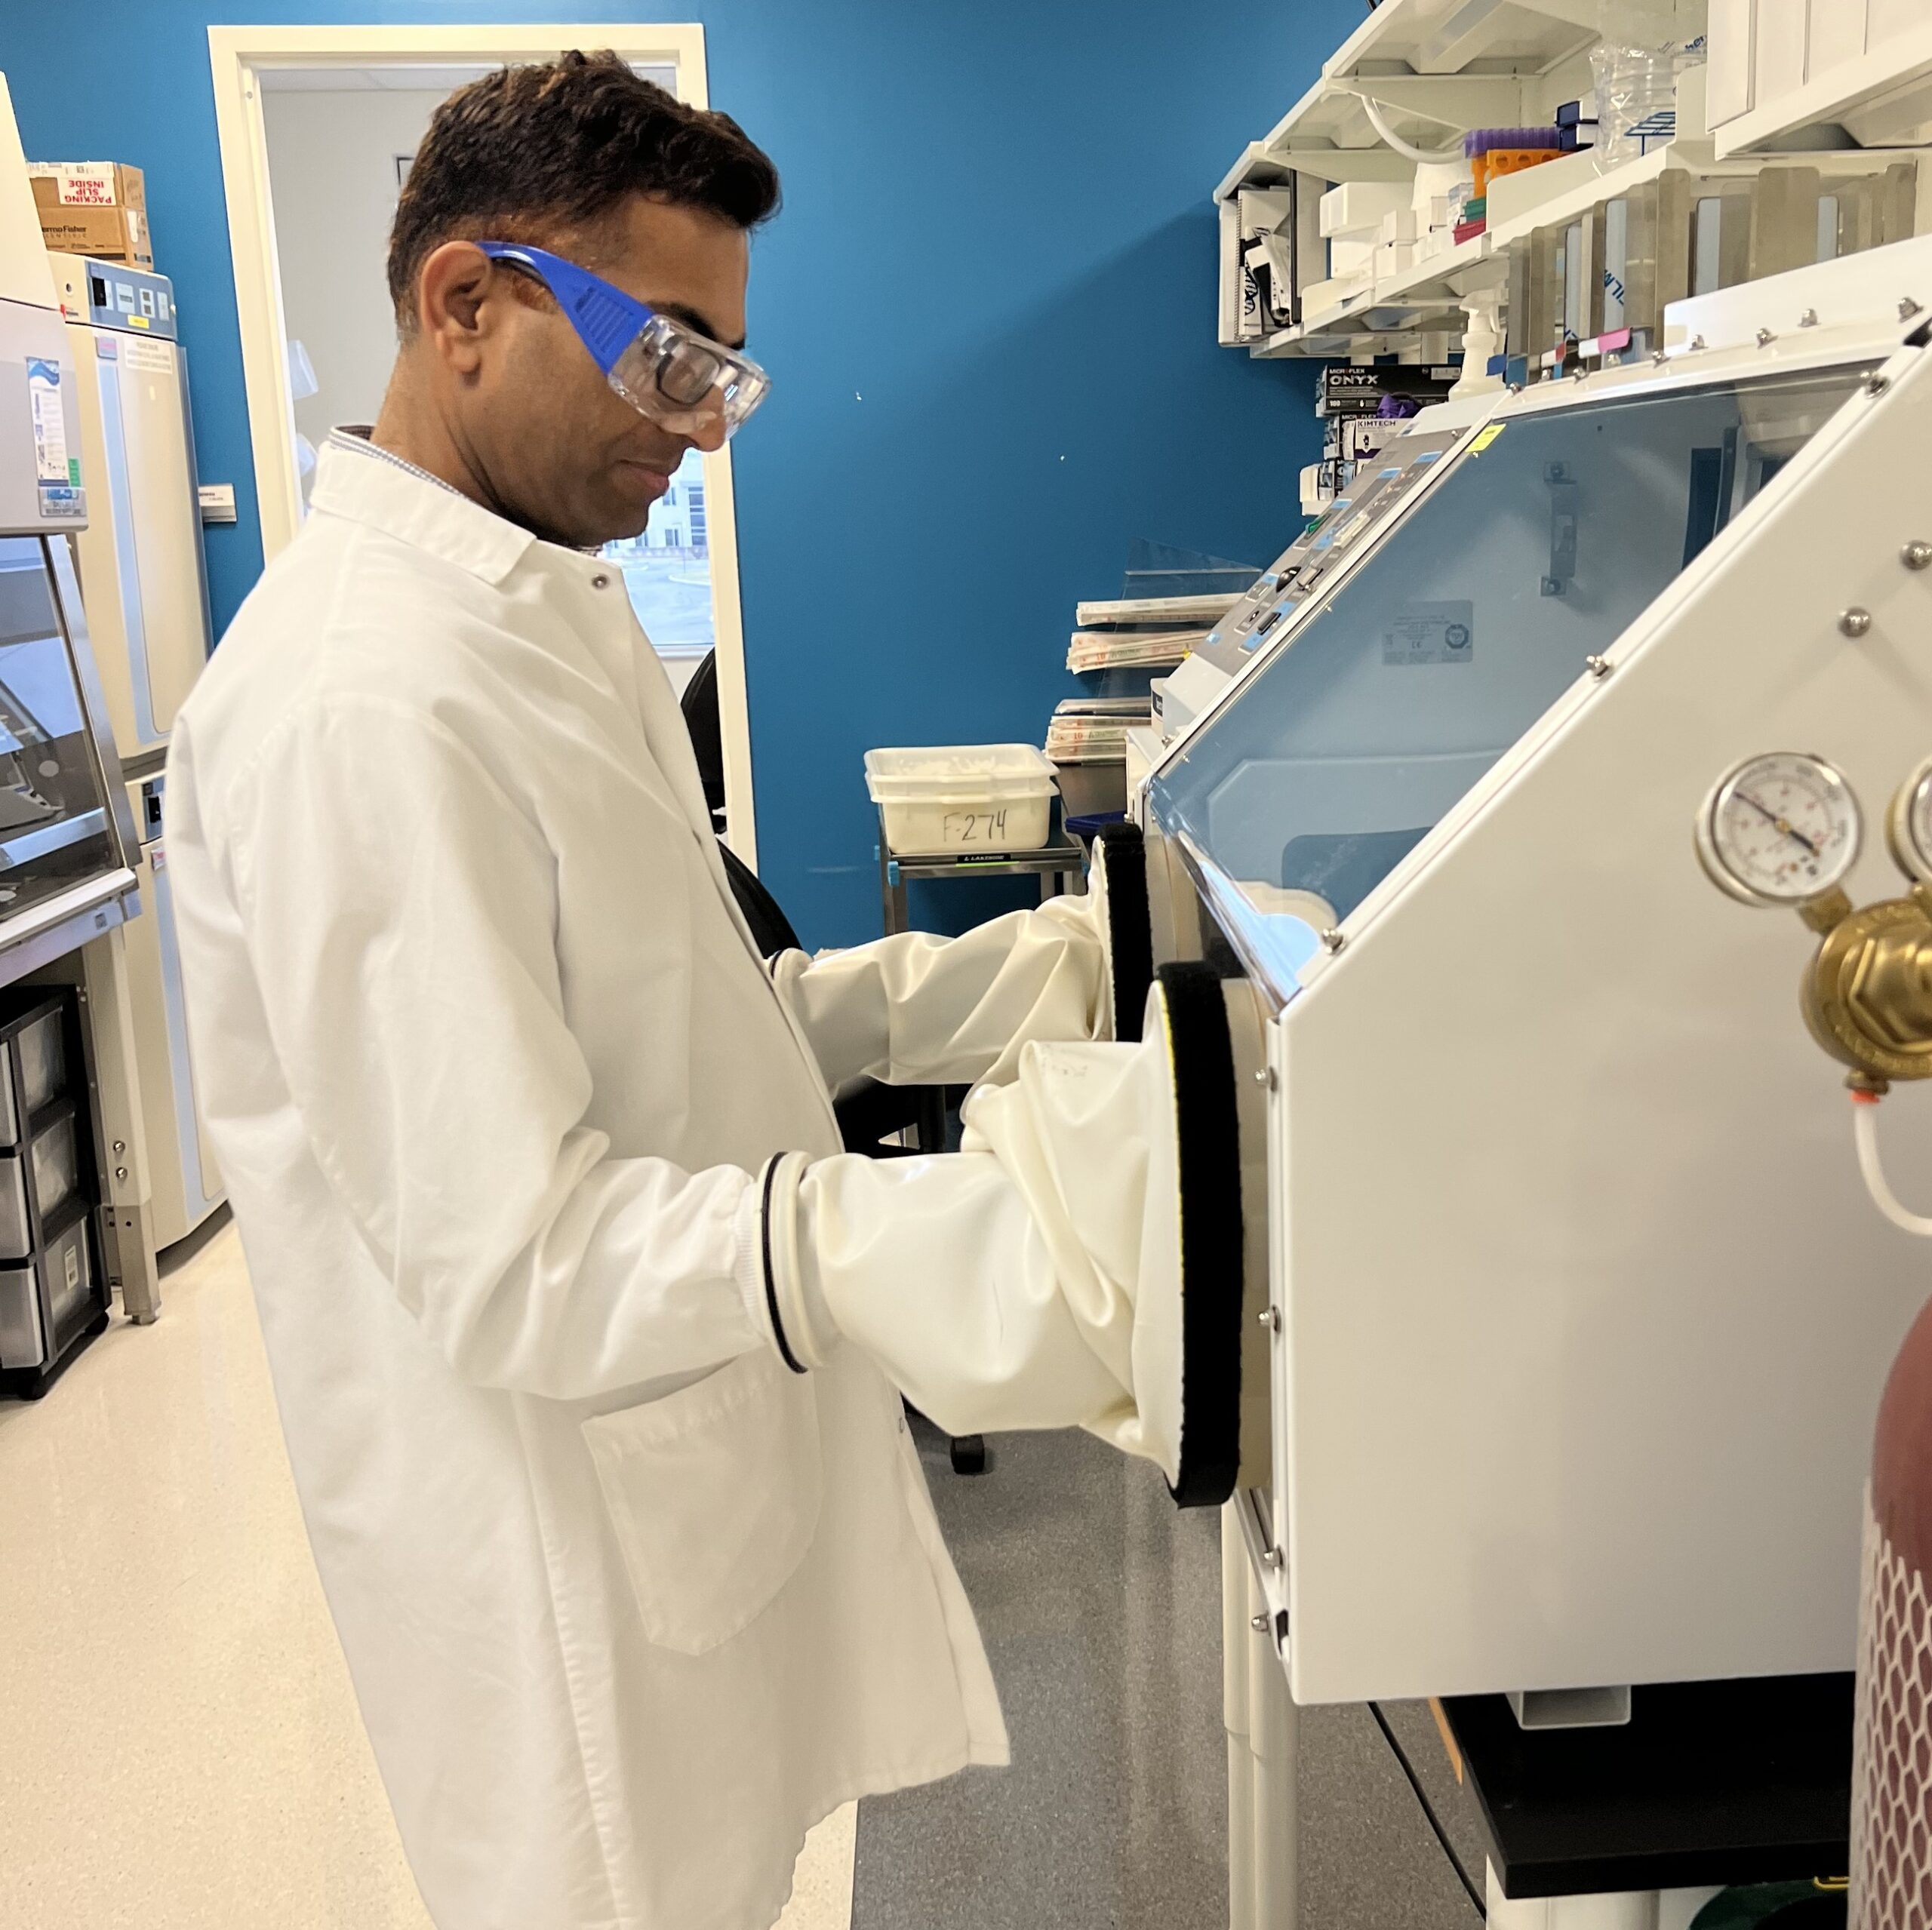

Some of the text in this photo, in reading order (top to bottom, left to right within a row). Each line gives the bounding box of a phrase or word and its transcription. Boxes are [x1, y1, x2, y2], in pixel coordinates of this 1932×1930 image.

[69, 180, 104, 188] INSIDE
[65, 195, 112, 204] PACKING
[1329, 374, 1380, 385] ONYX
